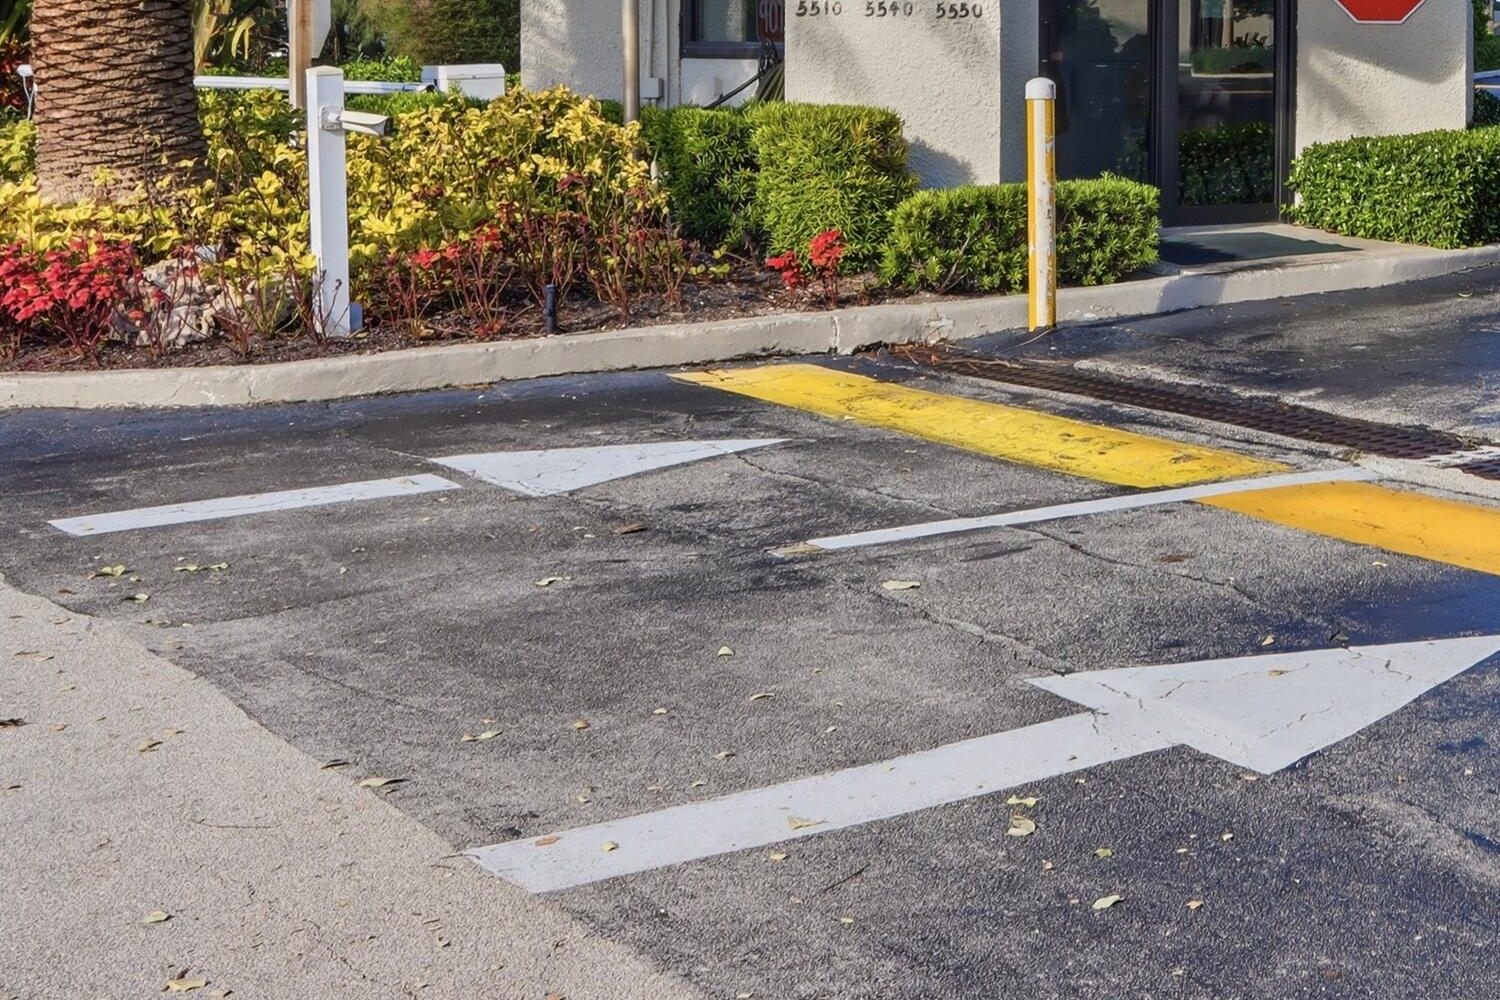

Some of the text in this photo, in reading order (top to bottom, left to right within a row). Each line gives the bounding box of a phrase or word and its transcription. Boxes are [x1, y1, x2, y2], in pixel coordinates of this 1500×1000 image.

[795, 0, 984, 19] 5510 5540 5550
